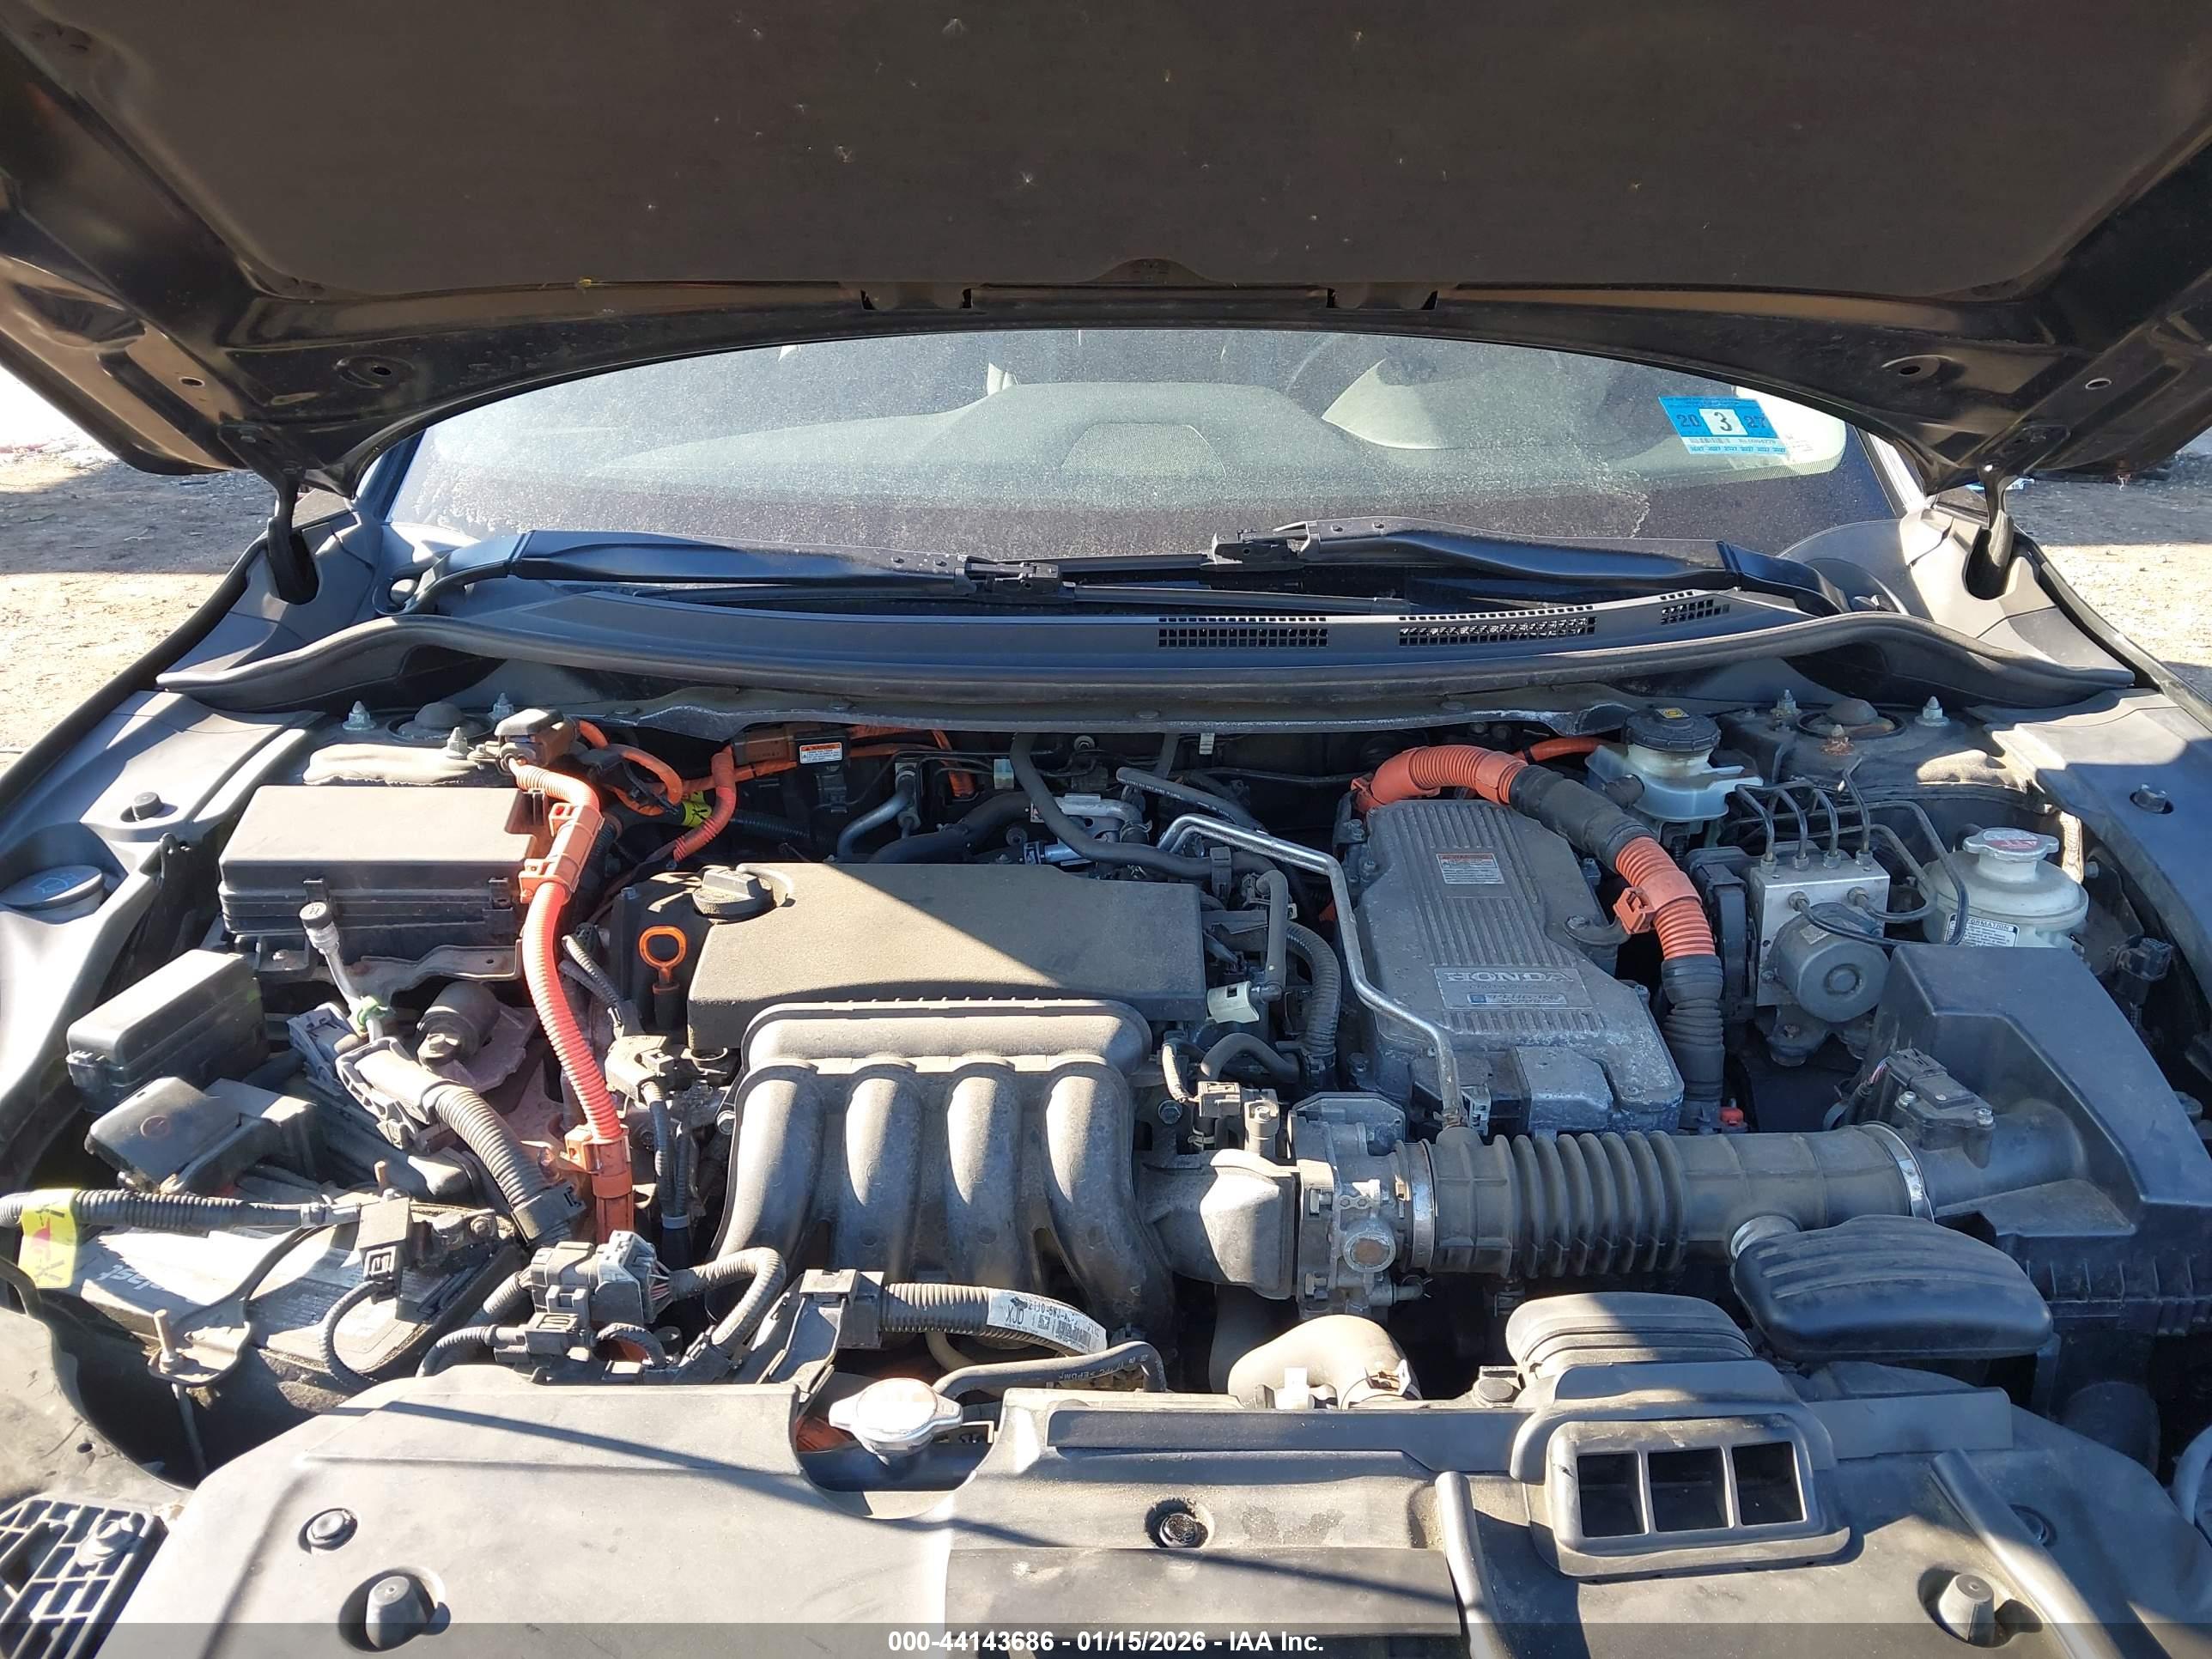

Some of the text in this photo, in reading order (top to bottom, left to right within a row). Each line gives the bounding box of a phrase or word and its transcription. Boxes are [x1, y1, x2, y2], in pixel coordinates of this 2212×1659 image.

[1677, 414, 1701, 428] 20
[1713, 410, 1733, 432] 3
[1443, 971, 1575, 982] HONDA
[1005, 1304, 1024, 1325] XJD
